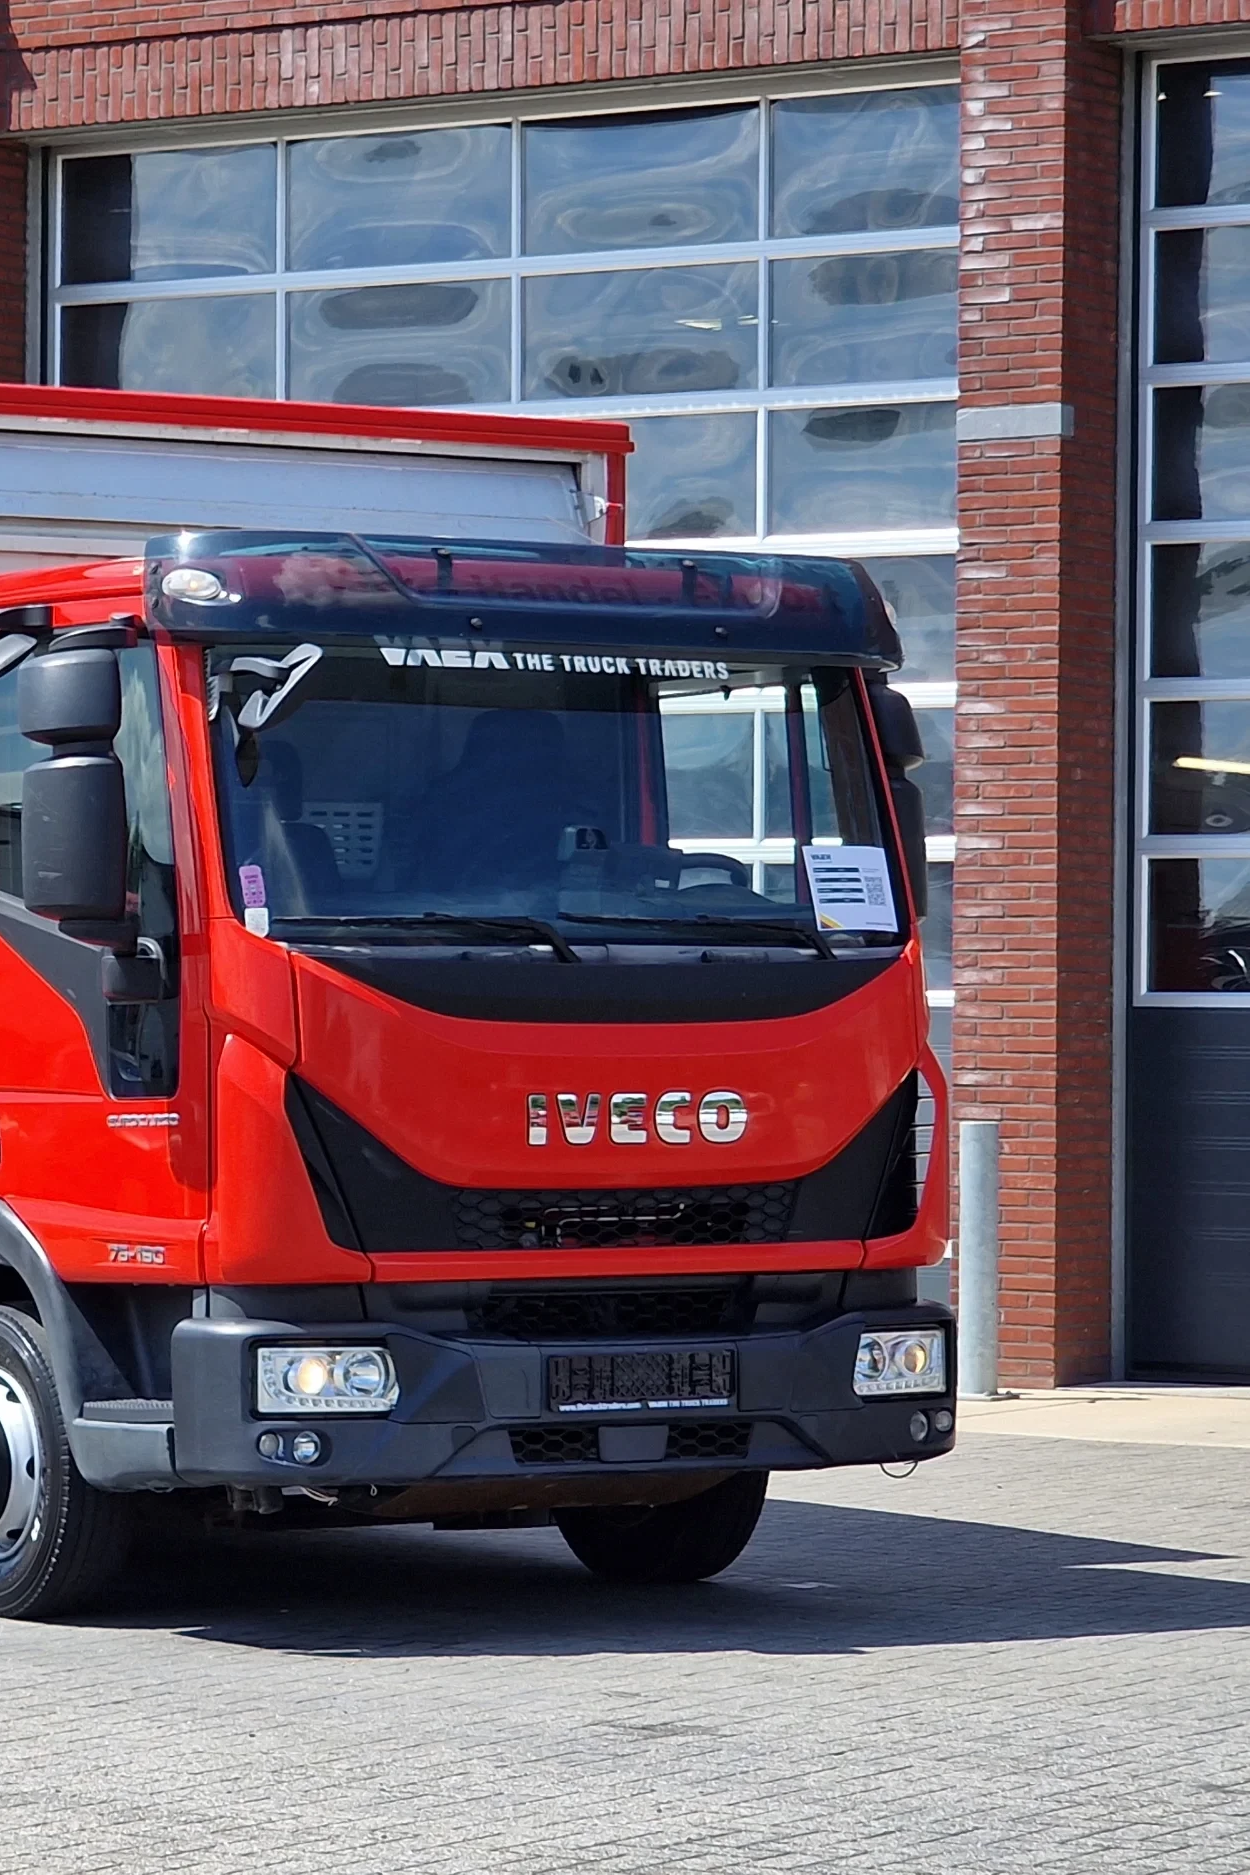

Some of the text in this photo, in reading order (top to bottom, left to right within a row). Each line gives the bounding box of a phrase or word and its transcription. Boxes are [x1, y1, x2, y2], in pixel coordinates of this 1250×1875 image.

[512, 652, 555, 671] THE
[559, 654, 631, 675] TRUCK
[635, 658, 729, 680] TRADERS
[527, 1090, 748, 1146] IVECO
